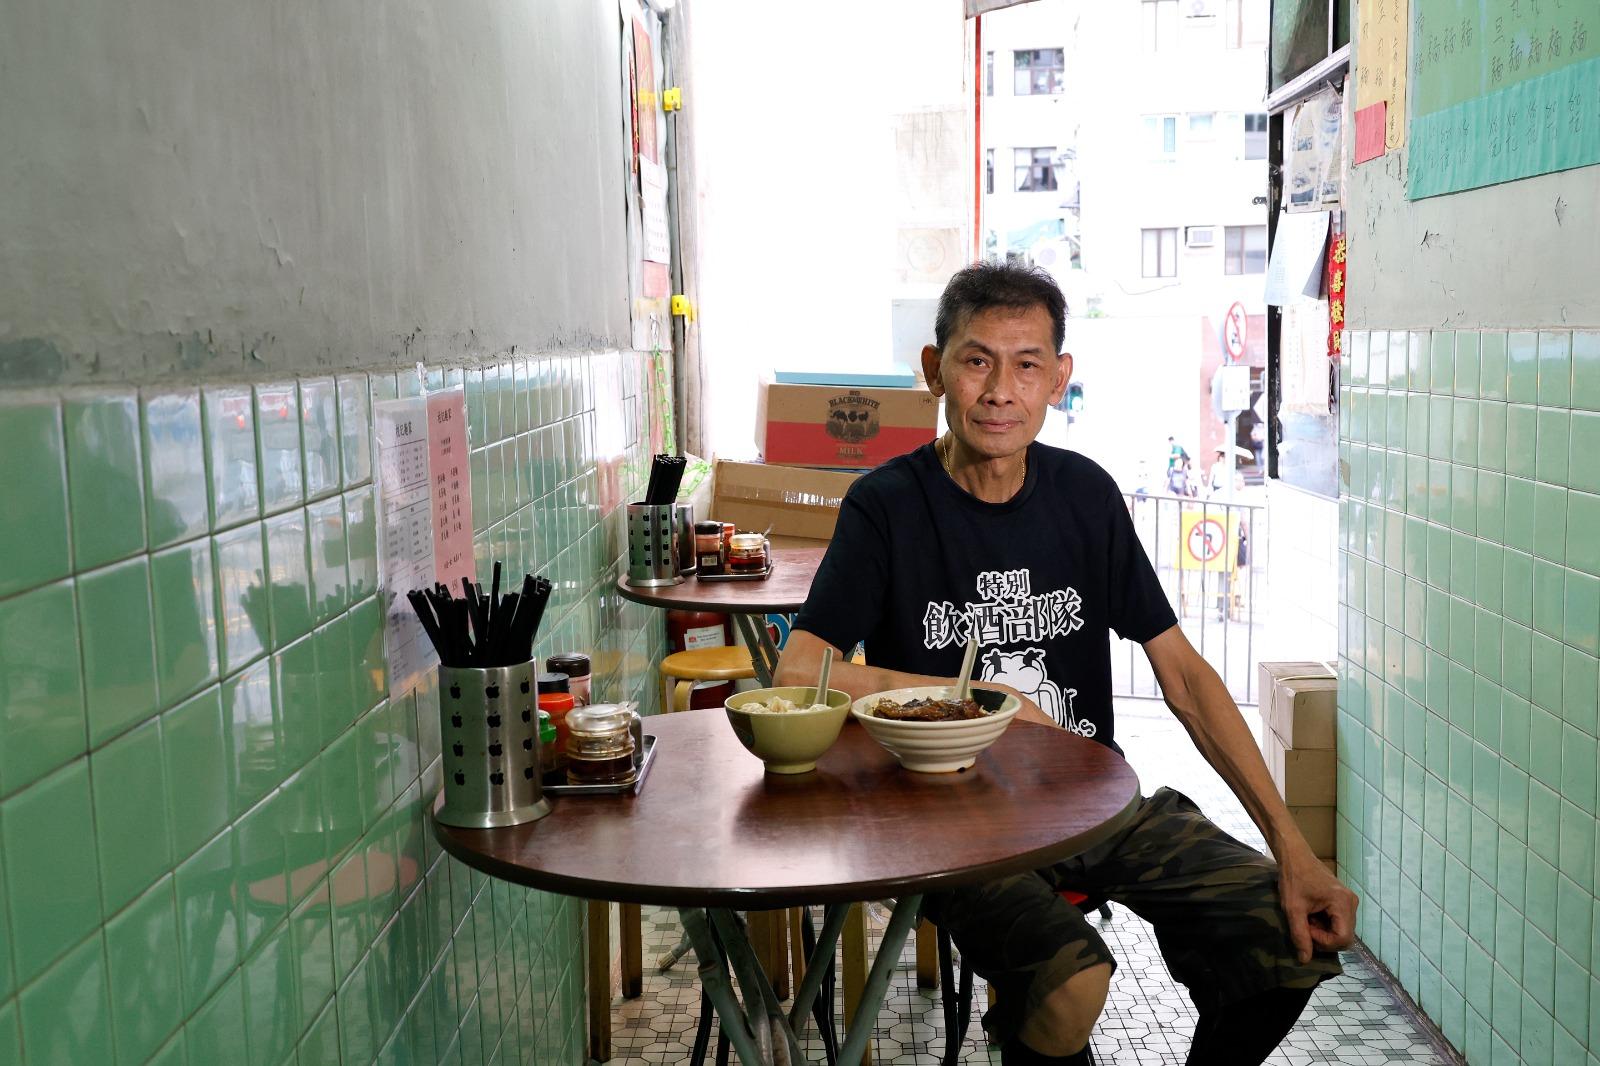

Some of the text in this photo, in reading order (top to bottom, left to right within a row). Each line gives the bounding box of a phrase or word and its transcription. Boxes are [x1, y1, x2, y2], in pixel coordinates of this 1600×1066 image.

[839, 447, 864, 456] MILK
[977, 569, 1031, 600] 特別
[922, 587, 1084, 649] 飲酒部隊
